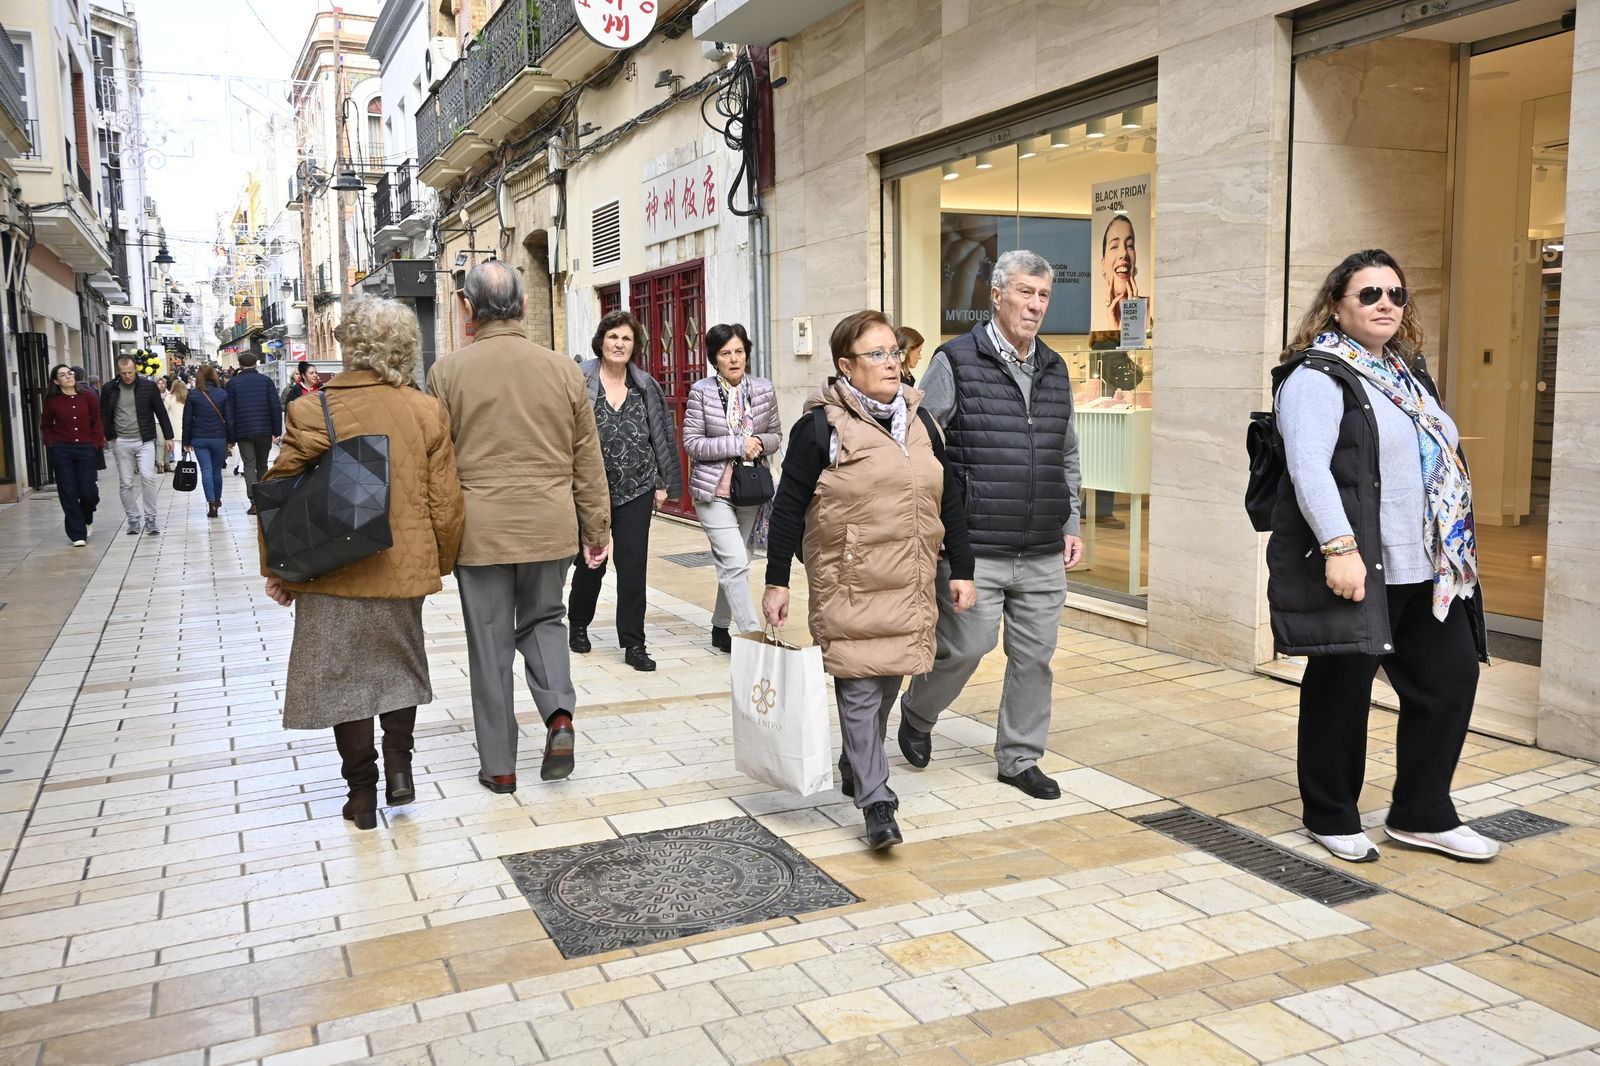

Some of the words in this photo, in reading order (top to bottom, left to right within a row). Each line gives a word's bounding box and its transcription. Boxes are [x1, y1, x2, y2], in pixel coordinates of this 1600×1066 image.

[1095, 189, 1119, 203] BLACK
[1120, 183, 1147, 199] FRIDAY
[1107, 200, 1125, 211] -40%
[1057, 277, 1080, 285] SIEMPRE
[1123, 302, 1138, 310] BLACK
[945, 309, 990, 321] MYTOUS
